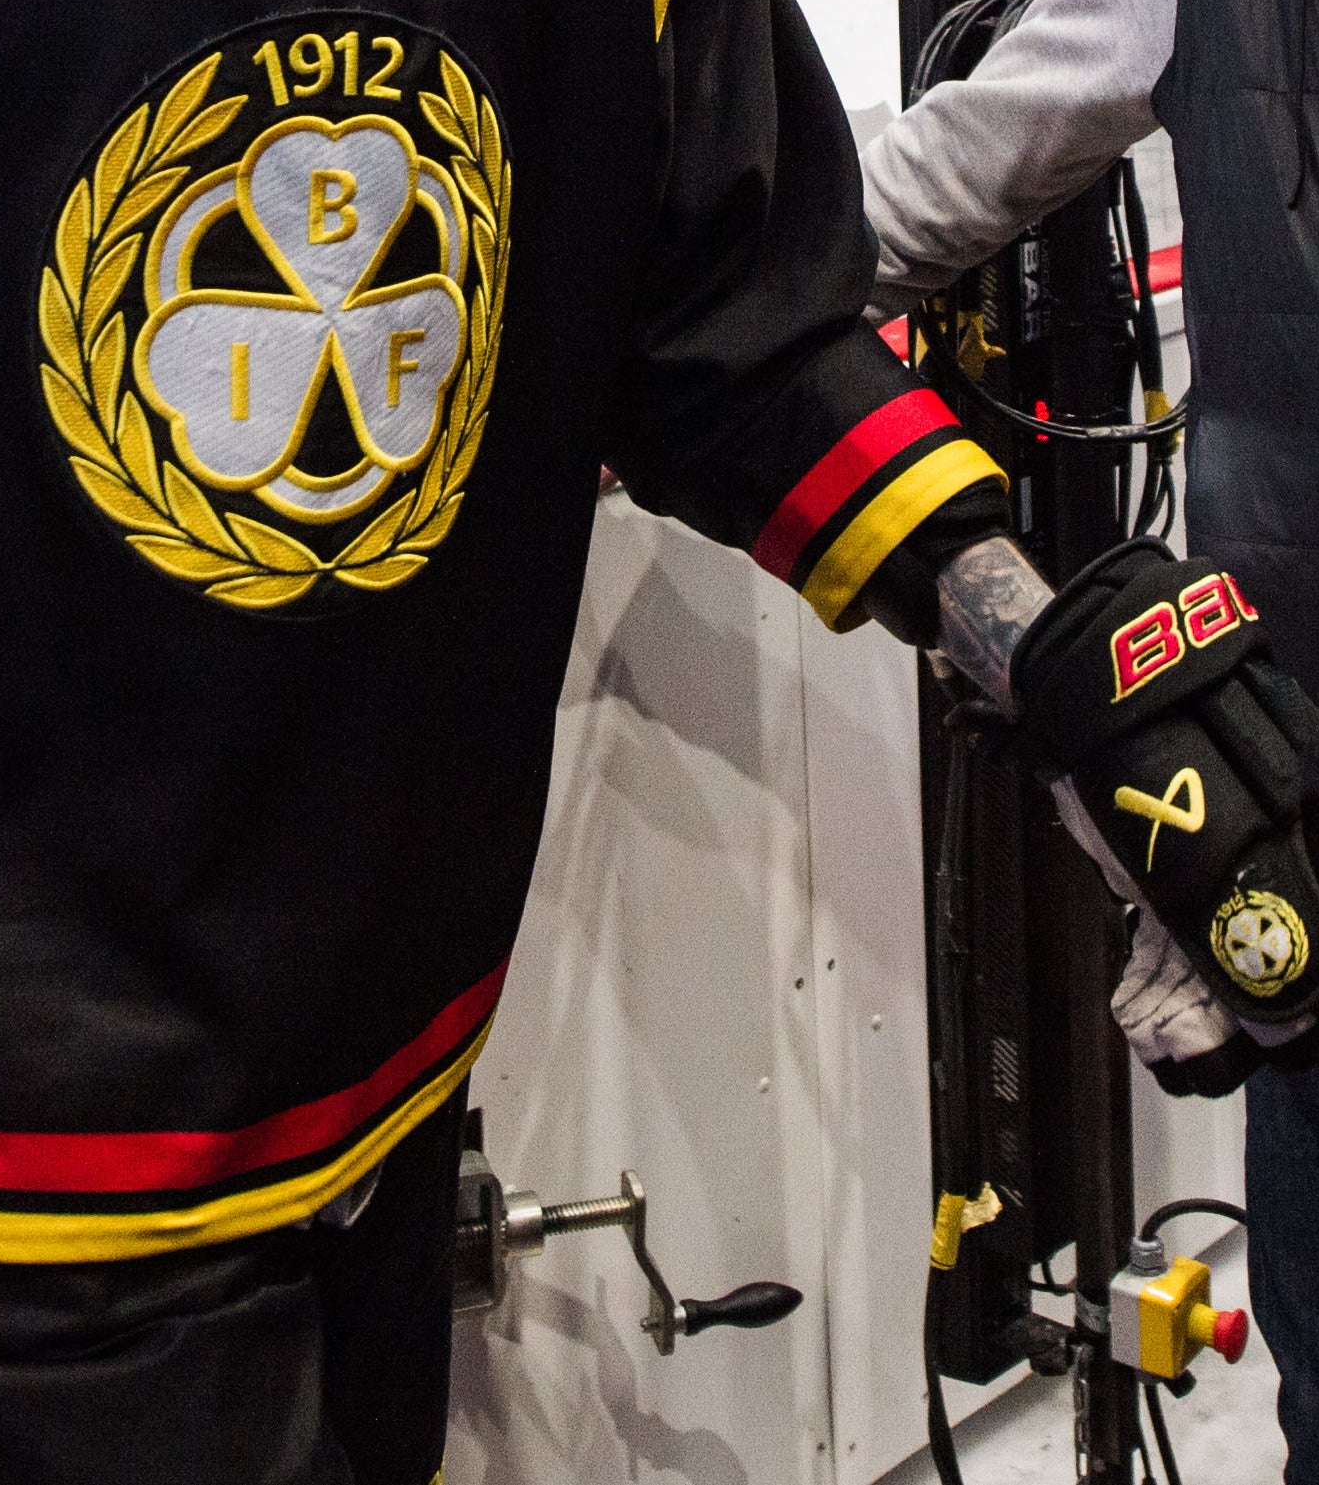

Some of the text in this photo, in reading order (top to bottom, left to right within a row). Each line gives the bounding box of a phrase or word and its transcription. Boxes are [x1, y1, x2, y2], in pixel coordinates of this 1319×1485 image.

[253, 30, 406, 107] 1912
[306, 168, 359, 246] B
[229, 328, 427, 421] I F
